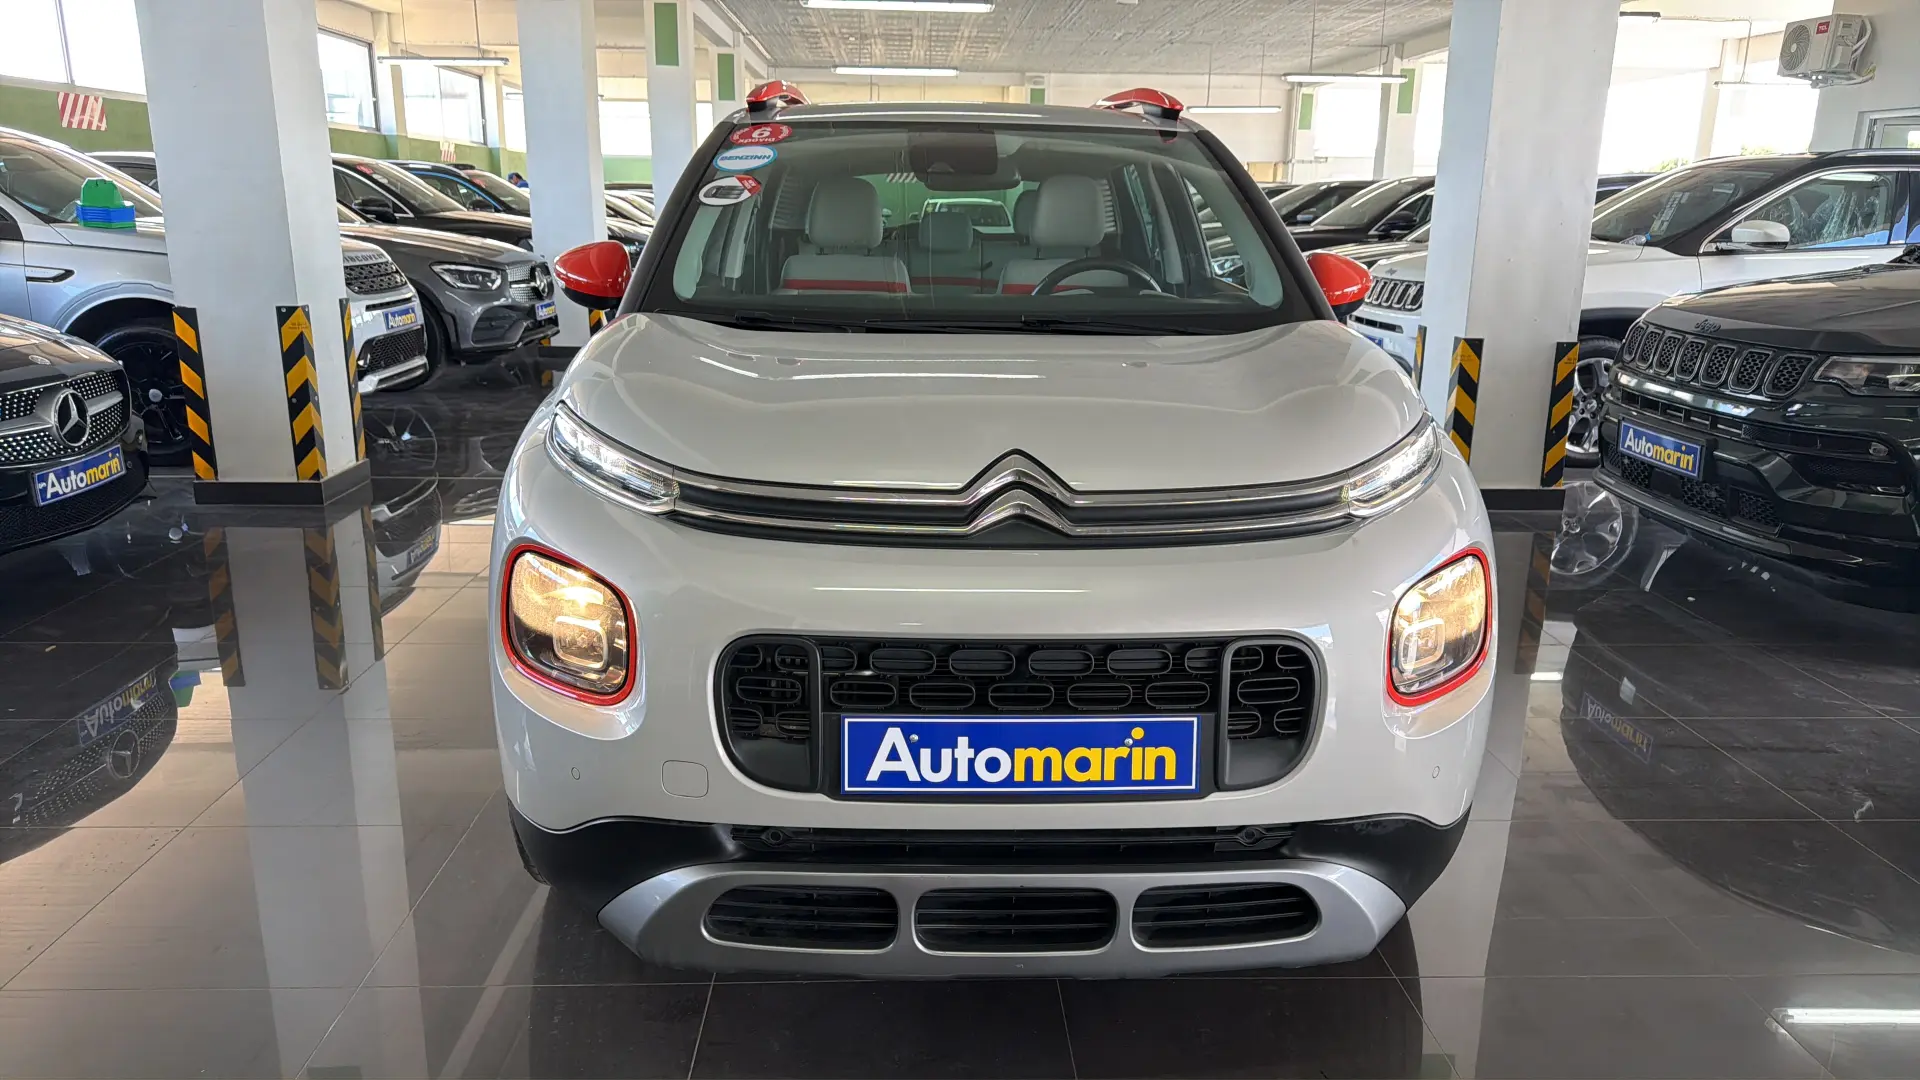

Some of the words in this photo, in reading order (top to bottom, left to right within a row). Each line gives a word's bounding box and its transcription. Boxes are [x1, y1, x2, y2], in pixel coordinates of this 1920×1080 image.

[752, 126, 772, 138] 6
[1624, 428, 1694, 471] Automarin
[46, 452, 121, 499] Automarin
[866, 727, 1177, 782] Automarin
